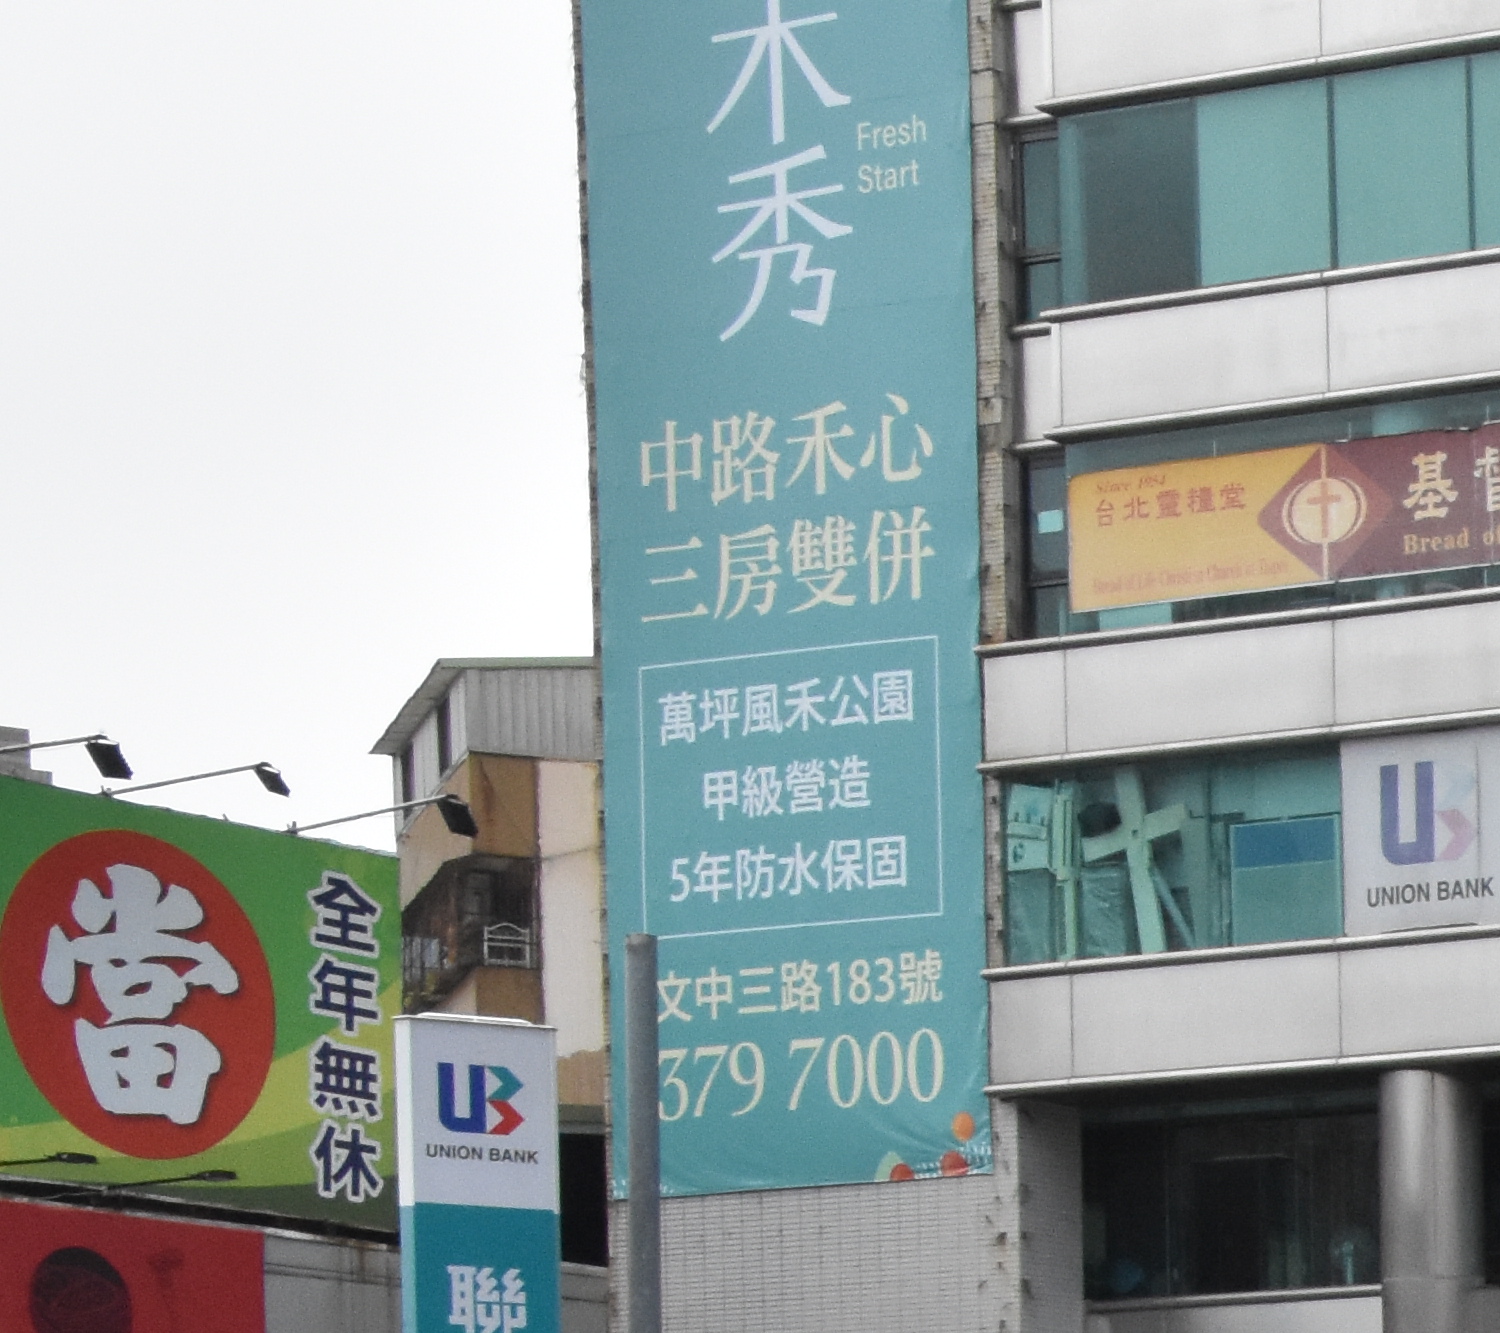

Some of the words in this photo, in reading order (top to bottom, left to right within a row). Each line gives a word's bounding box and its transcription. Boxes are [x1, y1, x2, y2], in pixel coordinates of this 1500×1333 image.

[856, 115, 927, 151] Fresh
[856, 162, 920, 193] Start
[640, 393, 934, 513] 中路禾心
[640, 506, 936, 624] 三房雙併
[1402, 530, 1469, 556] Bread
[658, 668, 915, 747] 萬坪風禾公園
[702, 754, 872, 821] 甲級營造
[670, 834, 908, 904] 5年防水保固
[1366, 881, 1432, 908] UNION
[1437, 876, 1495, 902] BANK
[40, 863, 240, 1127] 當
[656, 950, 943, 1024] 文中三路183號
[307, 871, 384, 1203] 全年無休
[658, 1041, 765, 1123] 379
[787, 1027, 945, 1112] 7000
[425, 1142, 483, 1162] UNION
[488, 1146, 539, 1166] BANK
